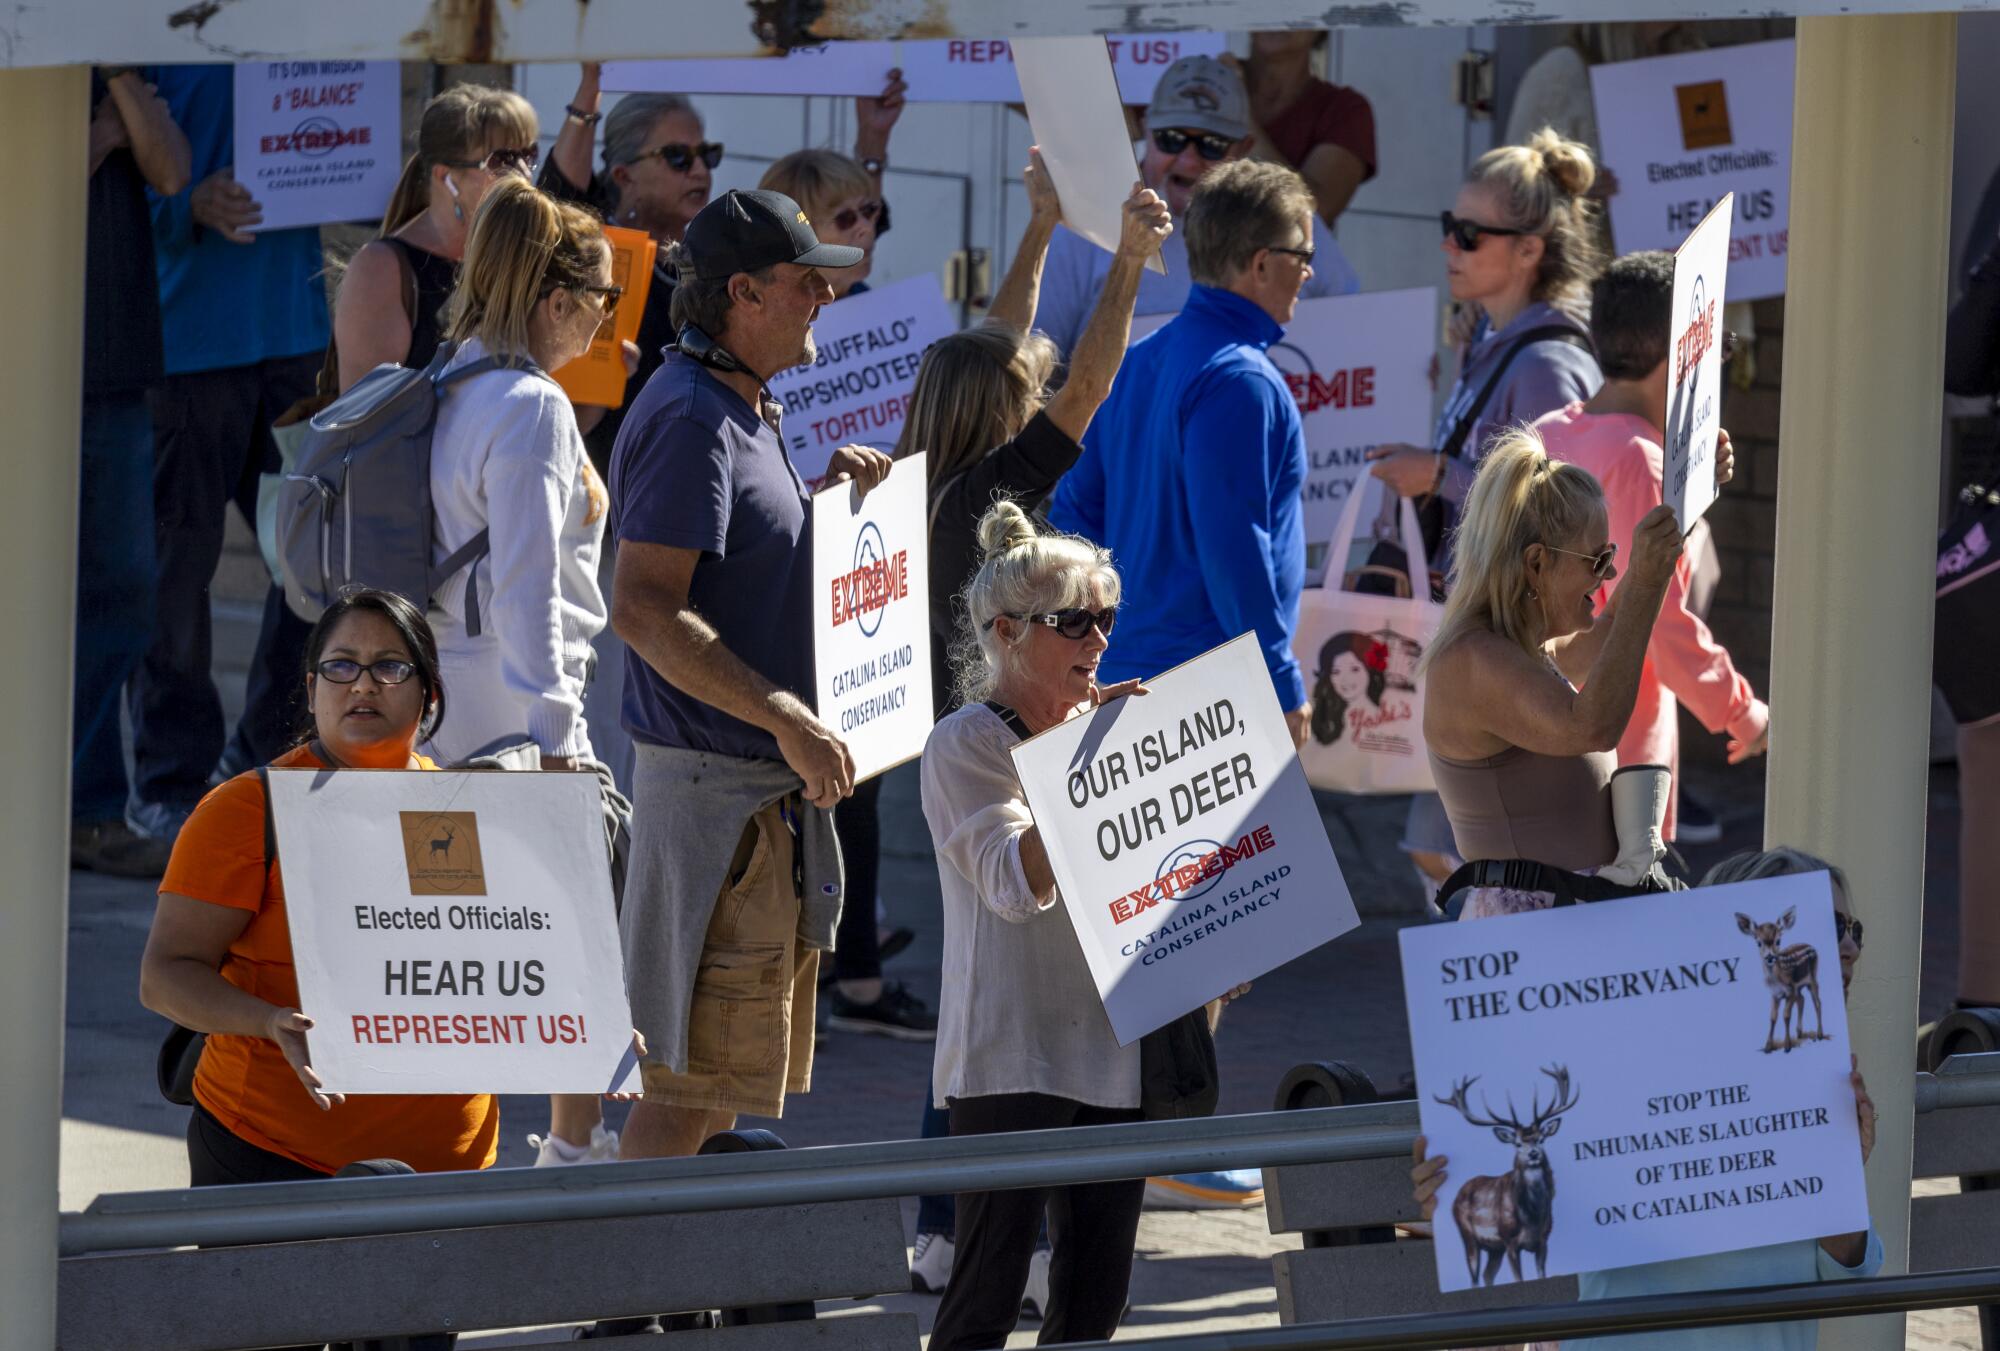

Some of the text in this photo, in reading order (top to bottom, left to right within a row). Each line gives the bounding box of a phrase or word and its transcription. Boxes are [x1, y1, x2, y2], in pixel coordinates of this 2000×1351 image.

[293, 61, 318, 77] OWN
[1131, 41, 1179, 64] US!
[260, 127, 371, 154] EXTREME
[258, 159, 375, 178] CATALINA ISLAND
[267, 173, 365, 190] CONSERVANCY
[1647, 150, 1777, 183] Elected Officials:
[1741, 190, 1774, 221] US
[1676, 298, 1715, 389] EXTREME
[831, 549, 908, 627] EXTREME
[832, 644, 912, 698] CATALINA ISLAND
[841, 684, 906, 733] CONSERVANCY
[1067, 698, 1245, 809] OUR ISLAND,
[1097, 752, 1257, 862] OUR DEER
[1108, 824, 1276, 925] EXTREME
[354, 905, 551, 930] Elected Officials:
[1121, 864, 1291, 957] CATALINA ISLAND
[1142, 888, 1282, 966] CONSERVANCY
[384, 959, 545, 997] HEAR US
[1441, 950, 1520, 985] STOP
[1445, 957, 1740, 1022] THE CONSERVANCY
[351, 1014, 588, 1044] REPRESENT US!
[1647, 1084, 1751, 1117] STOP THE
[1573, 1107, 1830, 1161] INHUMANE SLAUGHTER
[1636, 1149, 1777, 1186] OF THE DEER
[1595, 1175, 1823, 1226] ON CATALINA ISLAND
